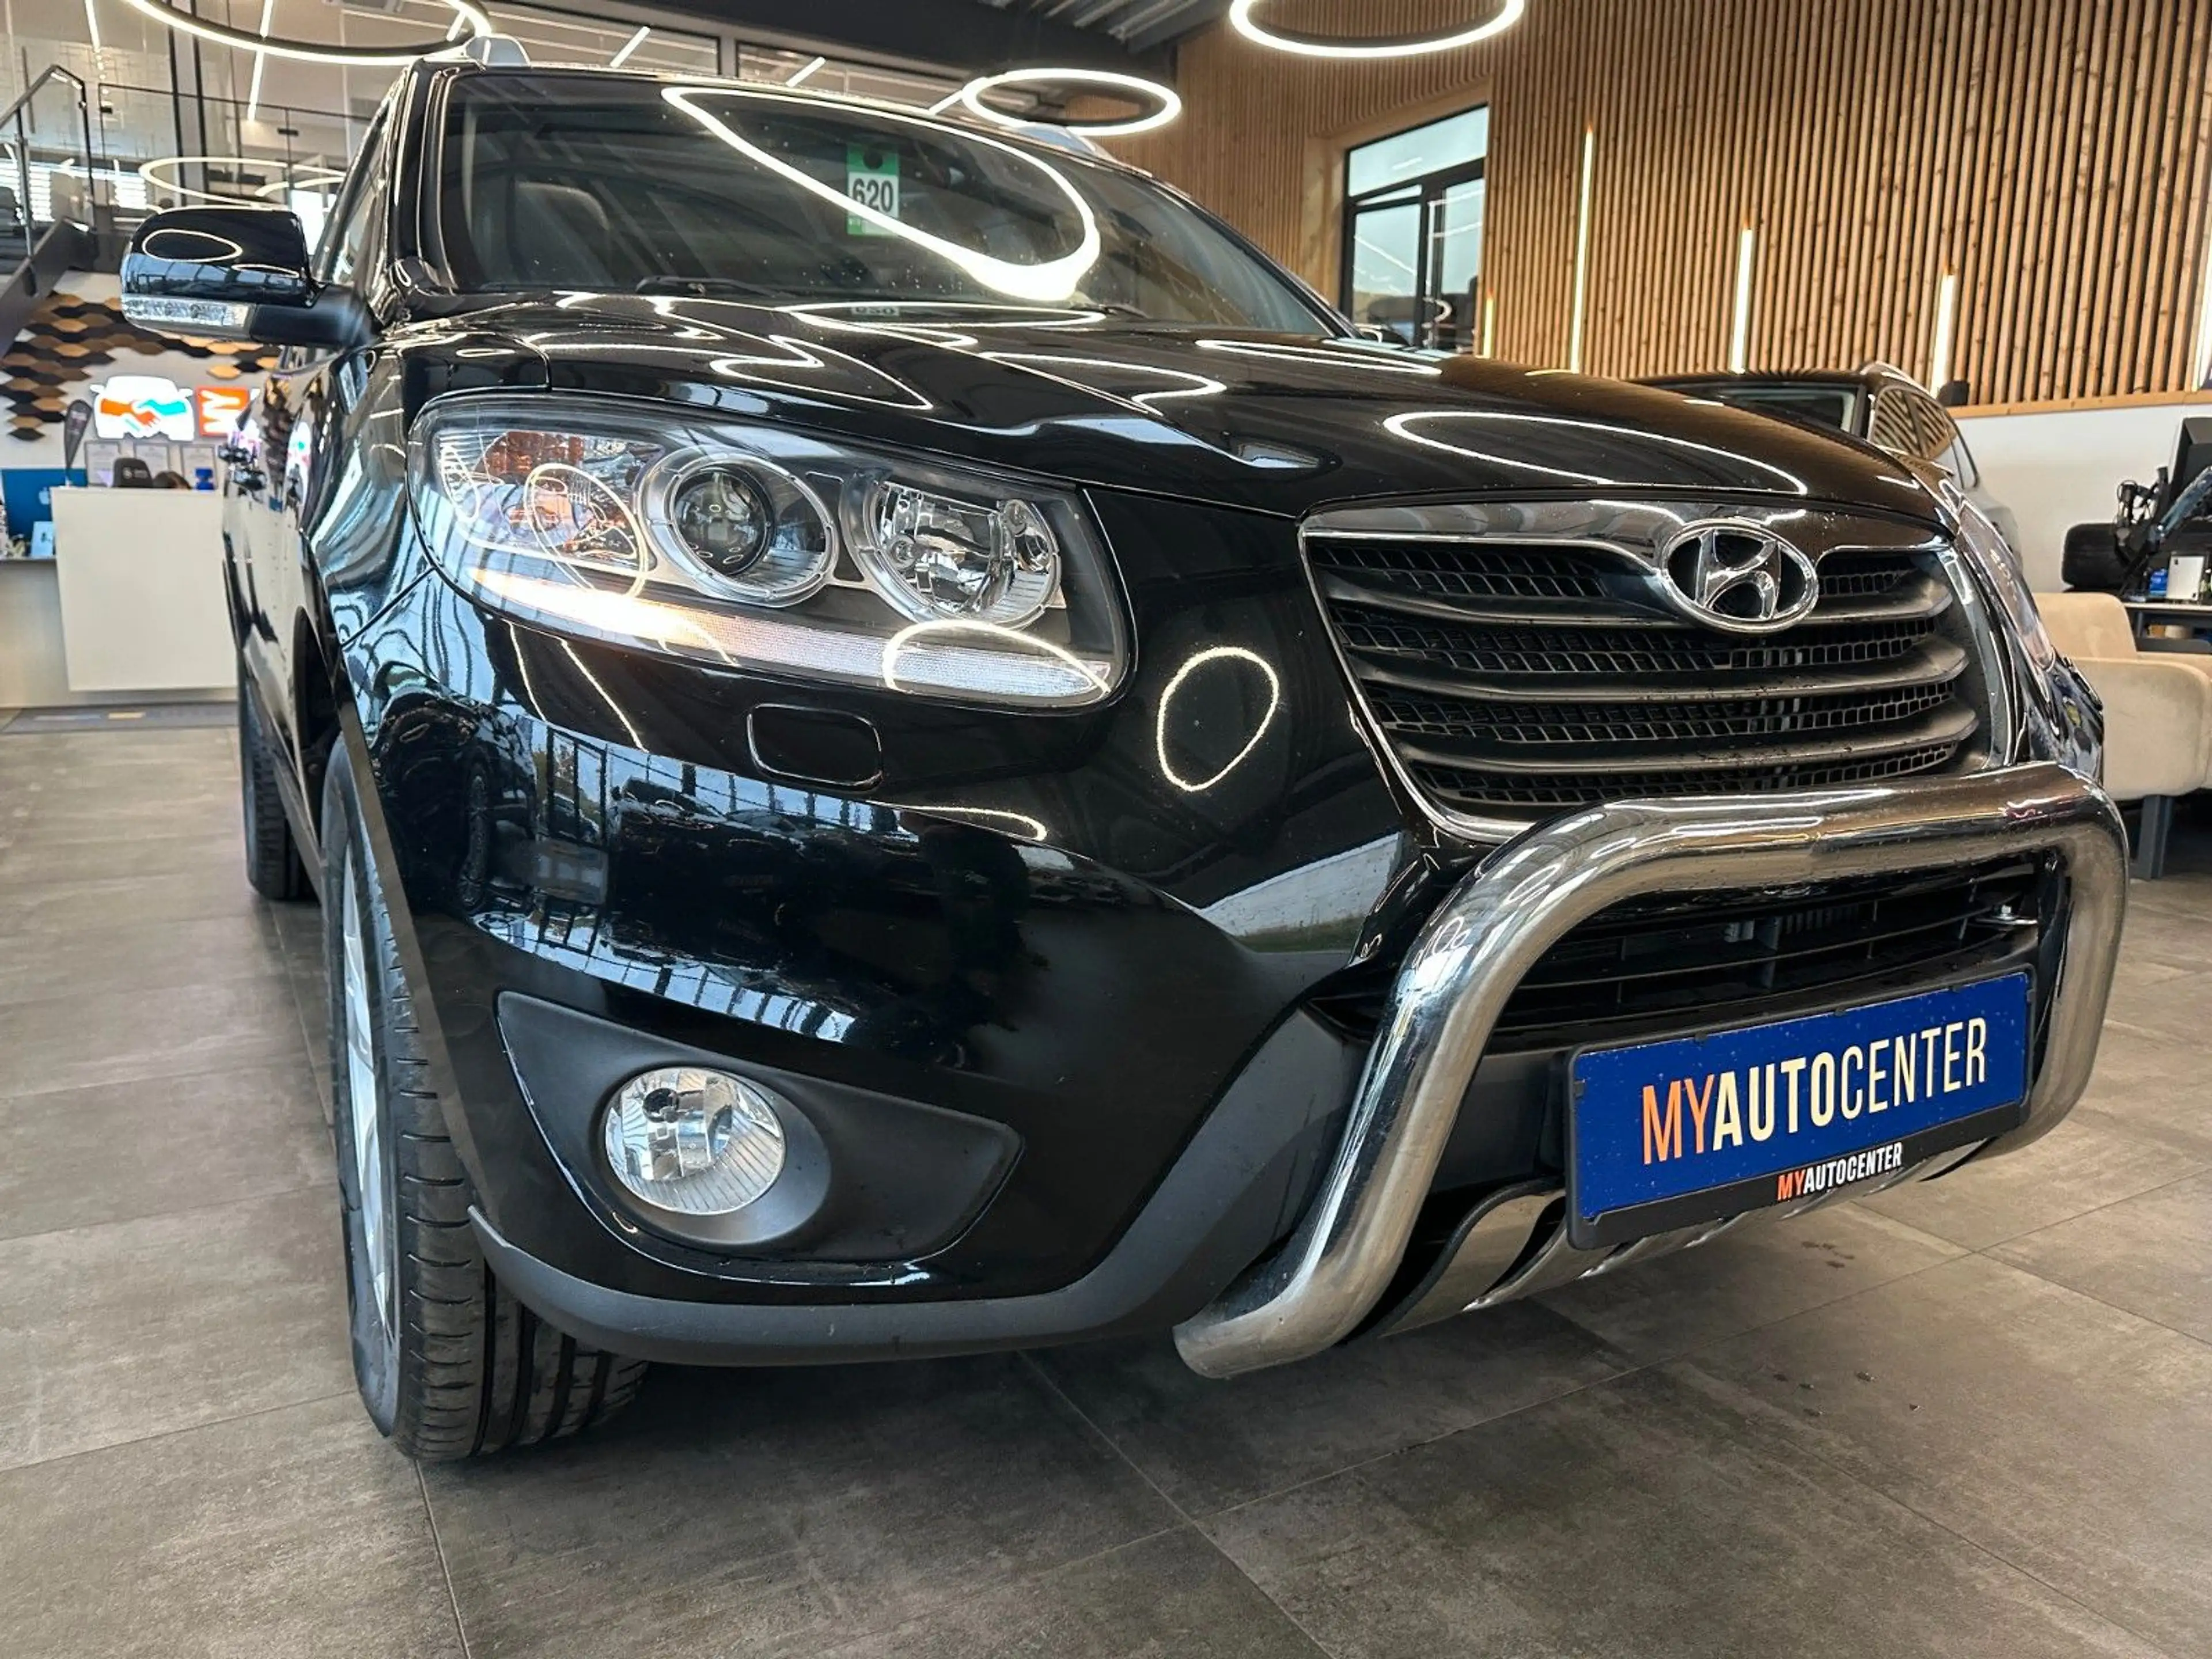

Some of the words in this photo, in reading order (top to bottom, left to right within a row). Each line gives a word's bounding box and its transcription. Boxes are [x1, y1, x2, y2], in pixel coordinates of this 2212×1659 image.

[853, 178, 893, 213] 620
[1642, 1017, 1987, 1165] MYAUTOCENTER
[1777, 1142, 1903, 1202] MYAUTOCENTER
